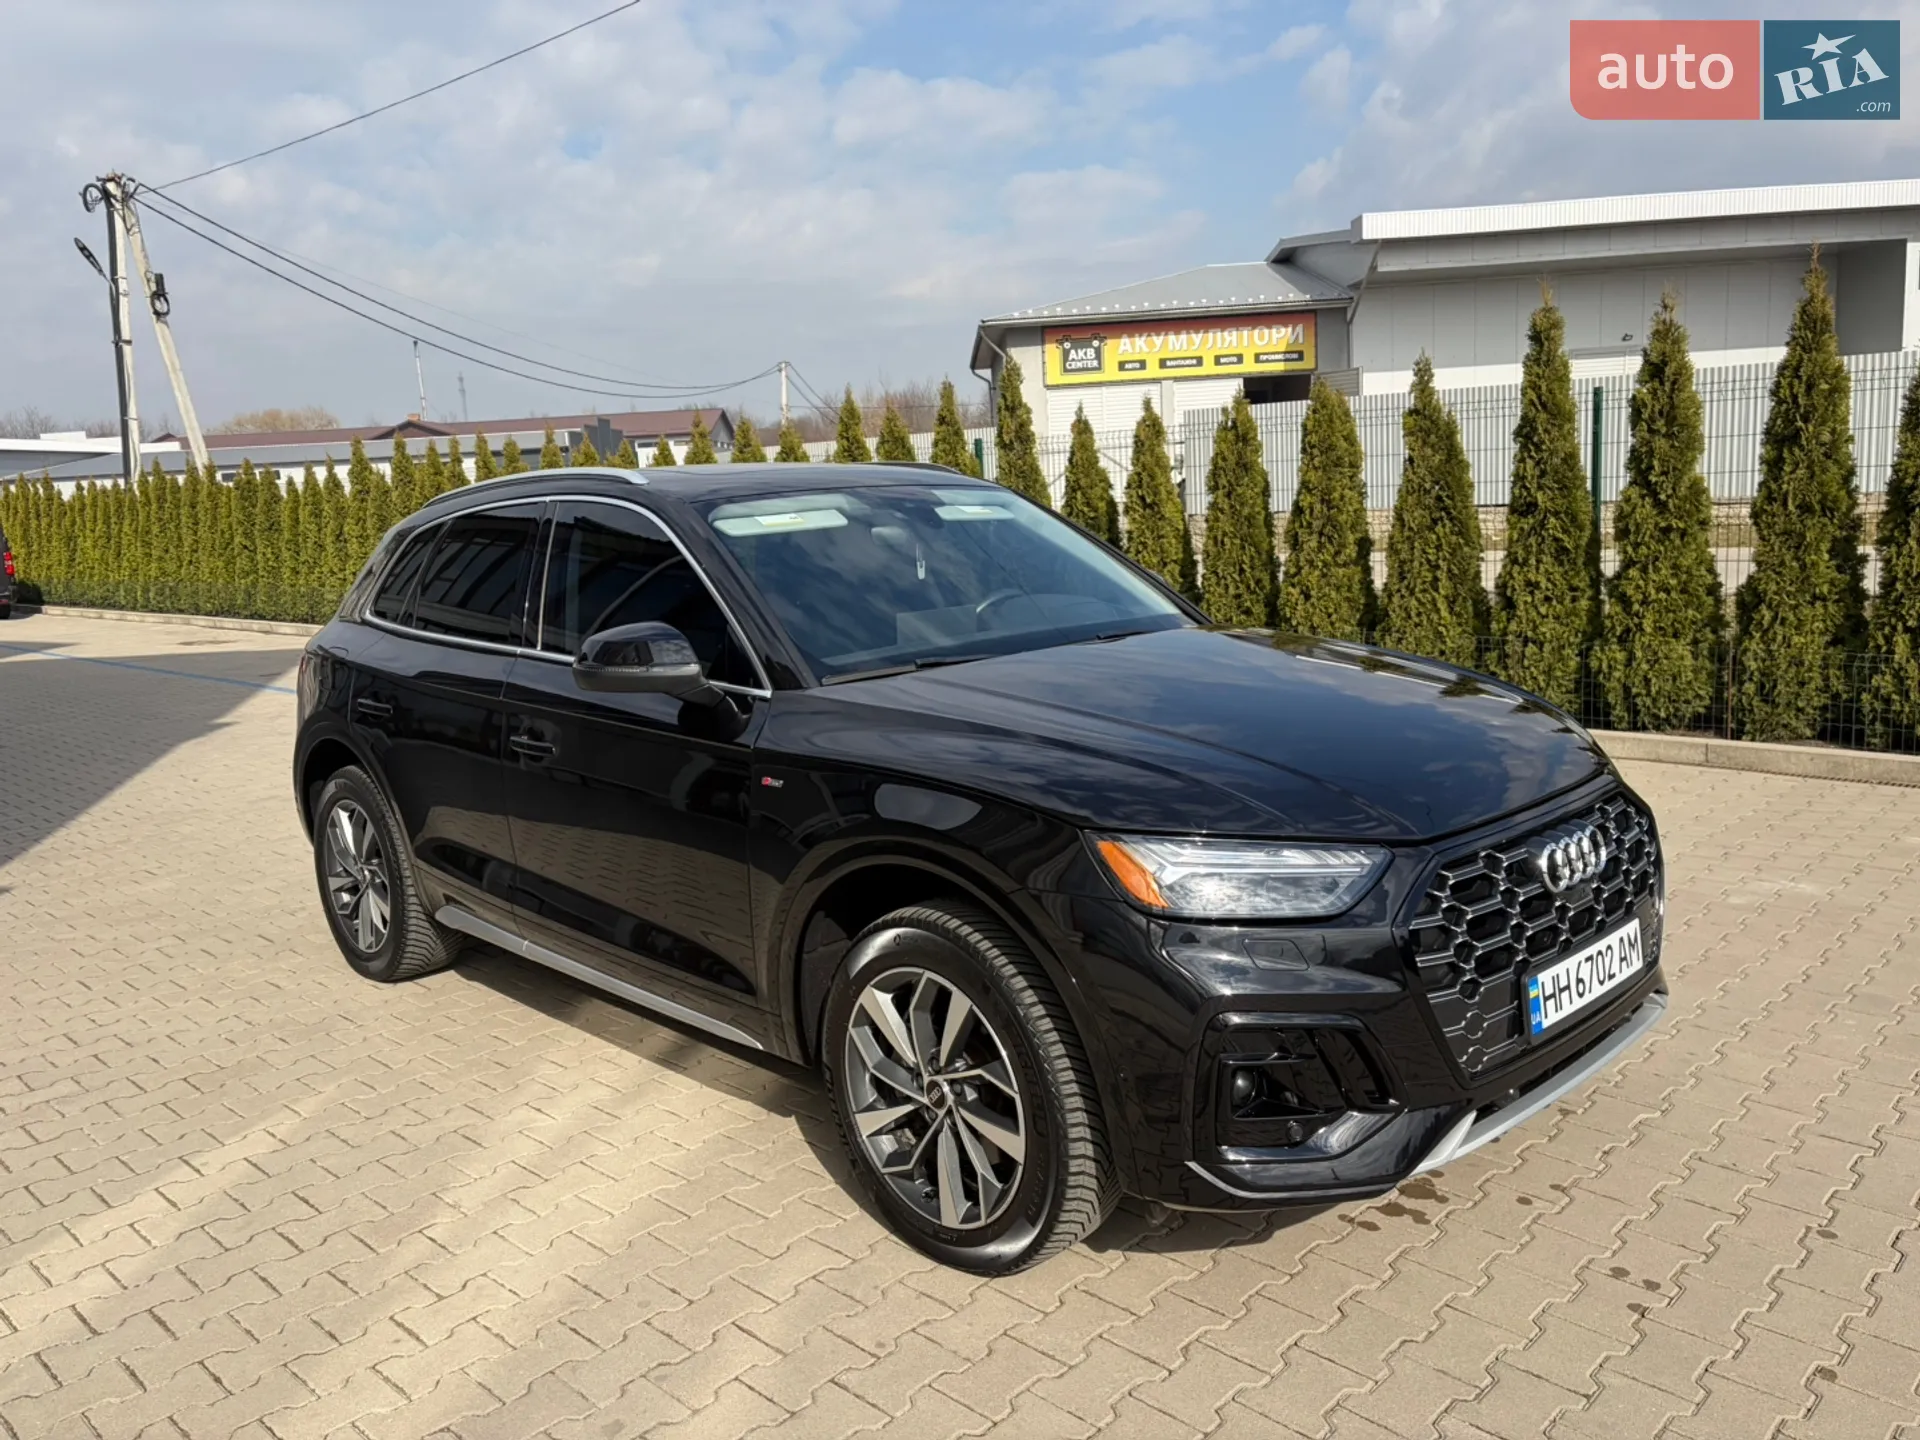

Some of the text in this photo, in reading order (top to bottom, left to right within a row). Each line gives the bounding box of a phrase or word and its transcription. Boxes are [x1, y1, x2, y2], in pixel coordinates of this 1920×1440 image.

[1118, 323, 1304, 355] АКУМУЛЯТОРИ
[1068, 348, 1096, 361] AKB
[1066, 360, 1099, 369] CENTER
[1124, 362, 1140, 370] АВТО
[1541, 927, 1640, 1019] HH 6702 AM
[1531, 1013, 1541, 1025] UA
